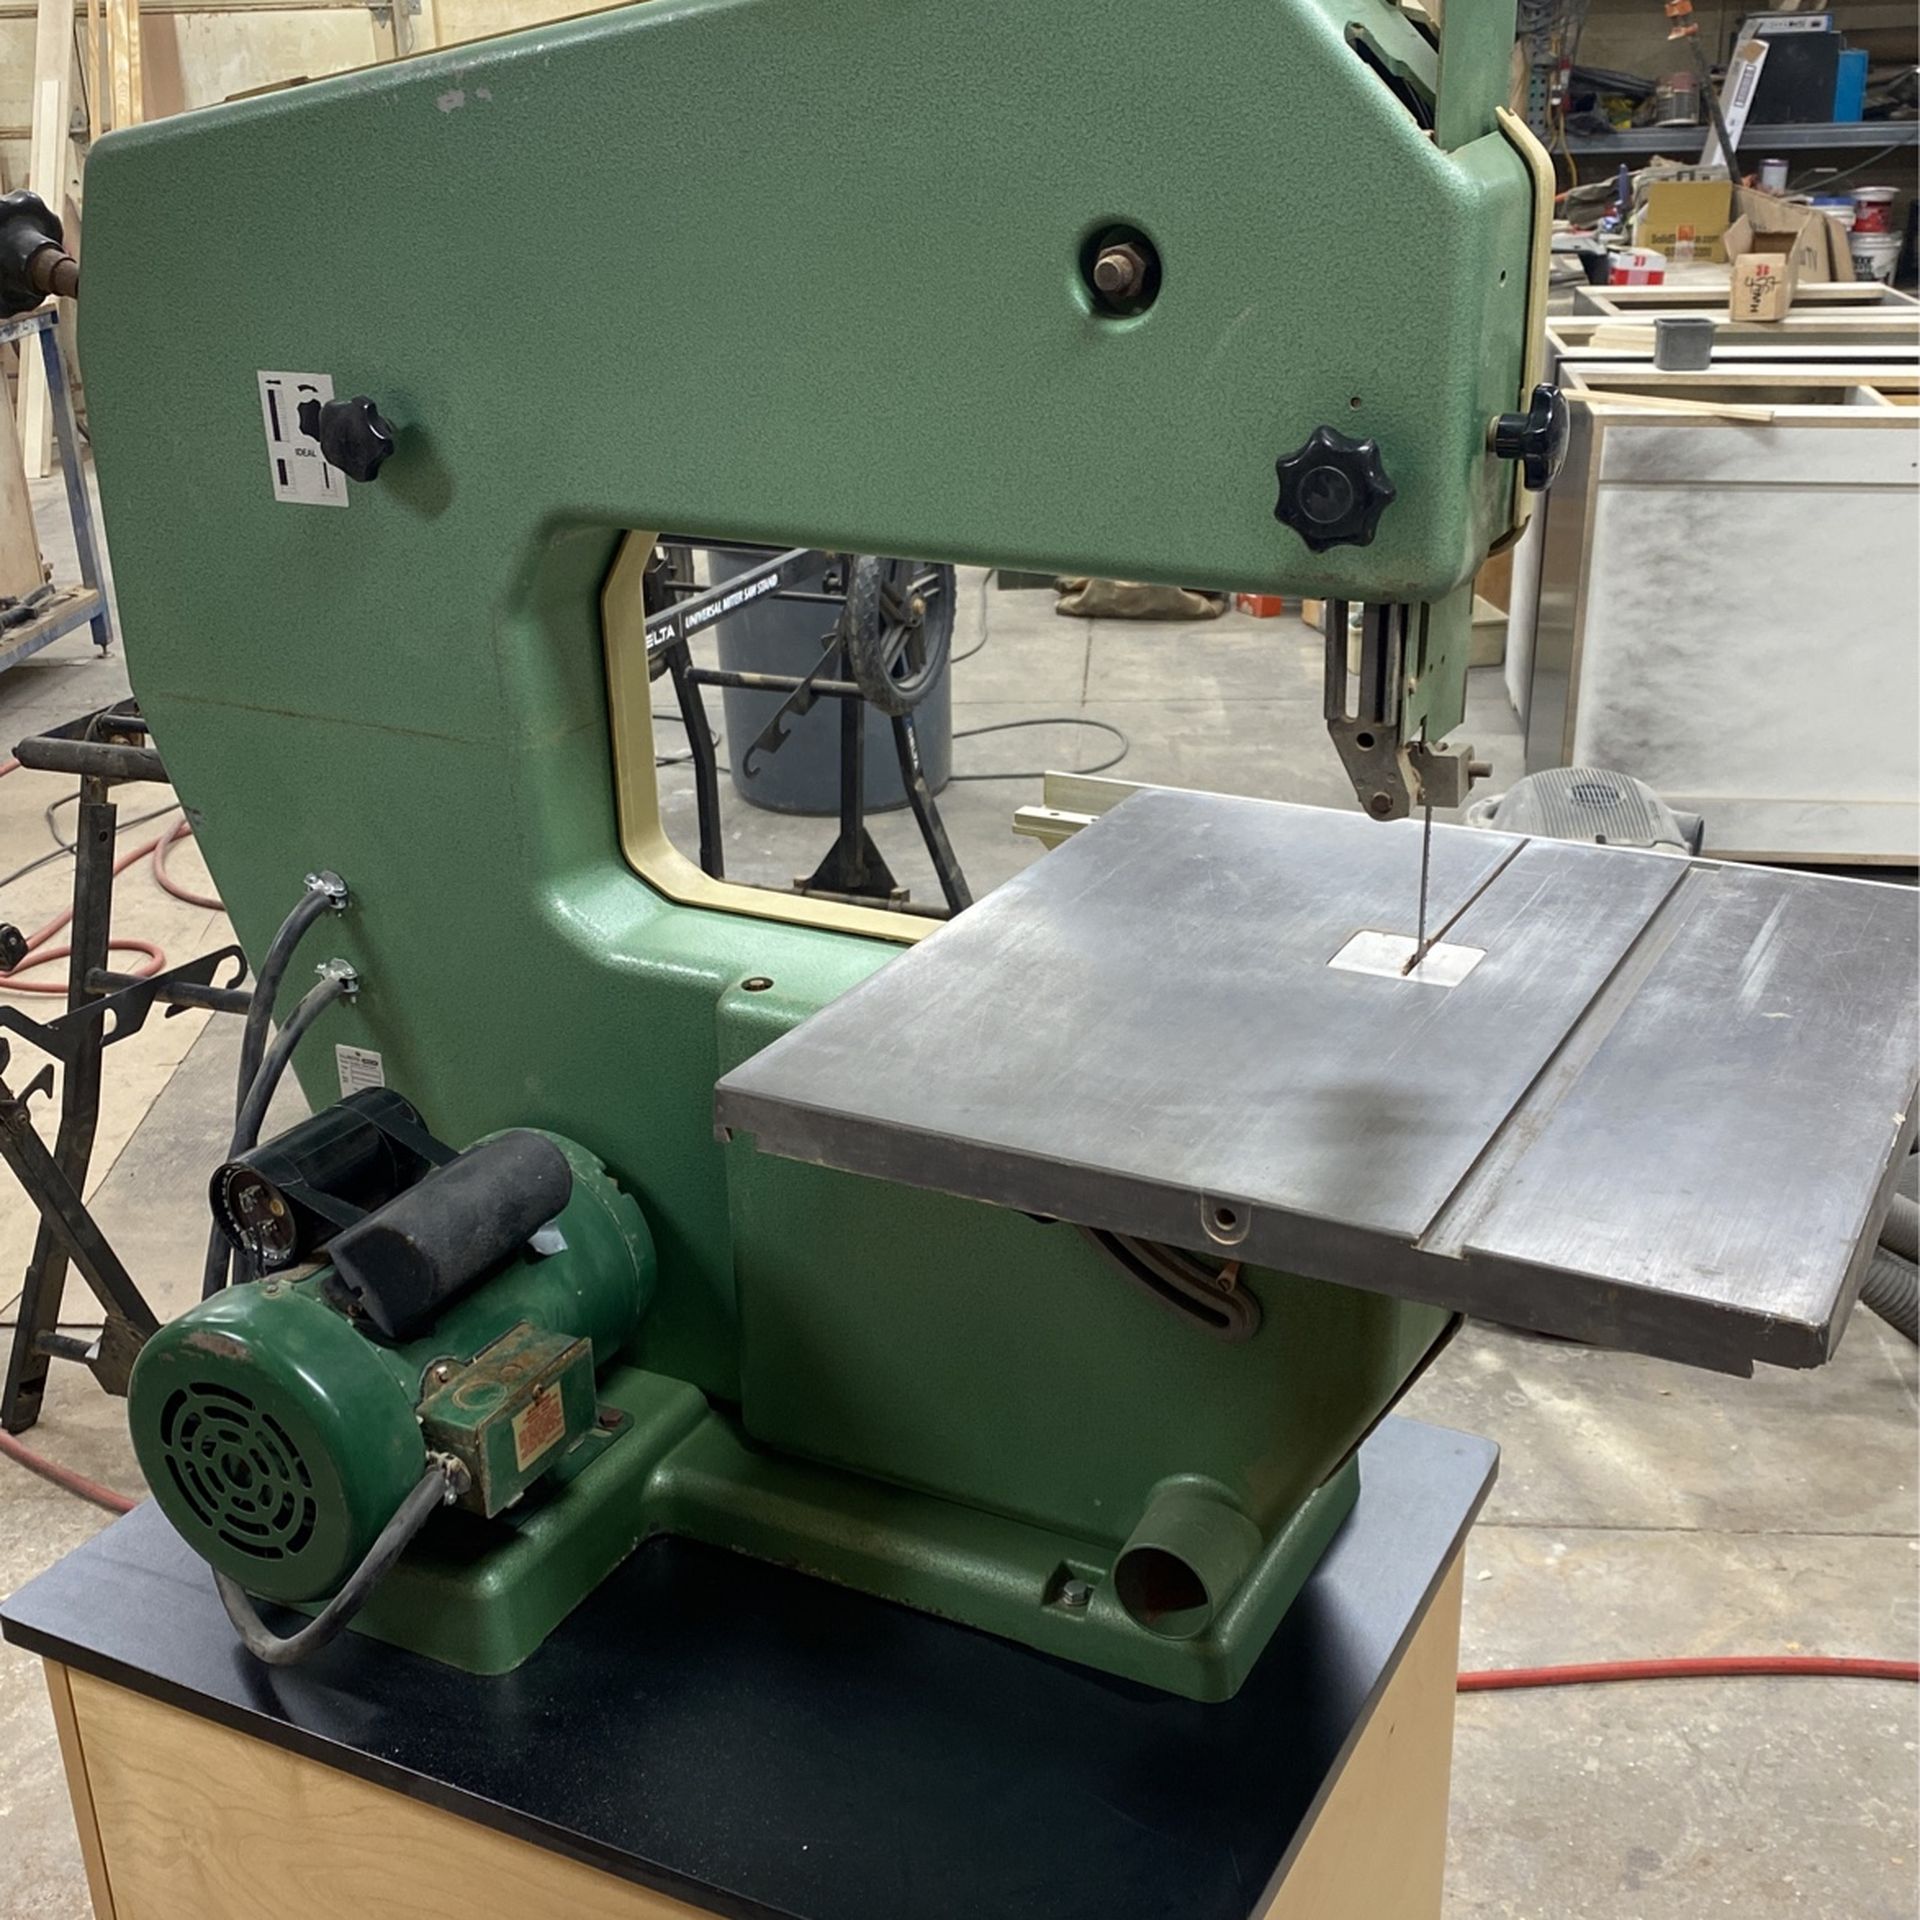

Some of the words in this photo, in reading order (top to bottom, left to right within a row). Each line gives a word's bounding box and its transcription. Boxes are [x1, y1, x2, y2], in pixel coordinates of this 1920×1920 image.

[295, 447, 317, 458] IDEAL
[645, 624, 676, 650] ELTA
[684, 600, 722, 629] UNIVERSAL
